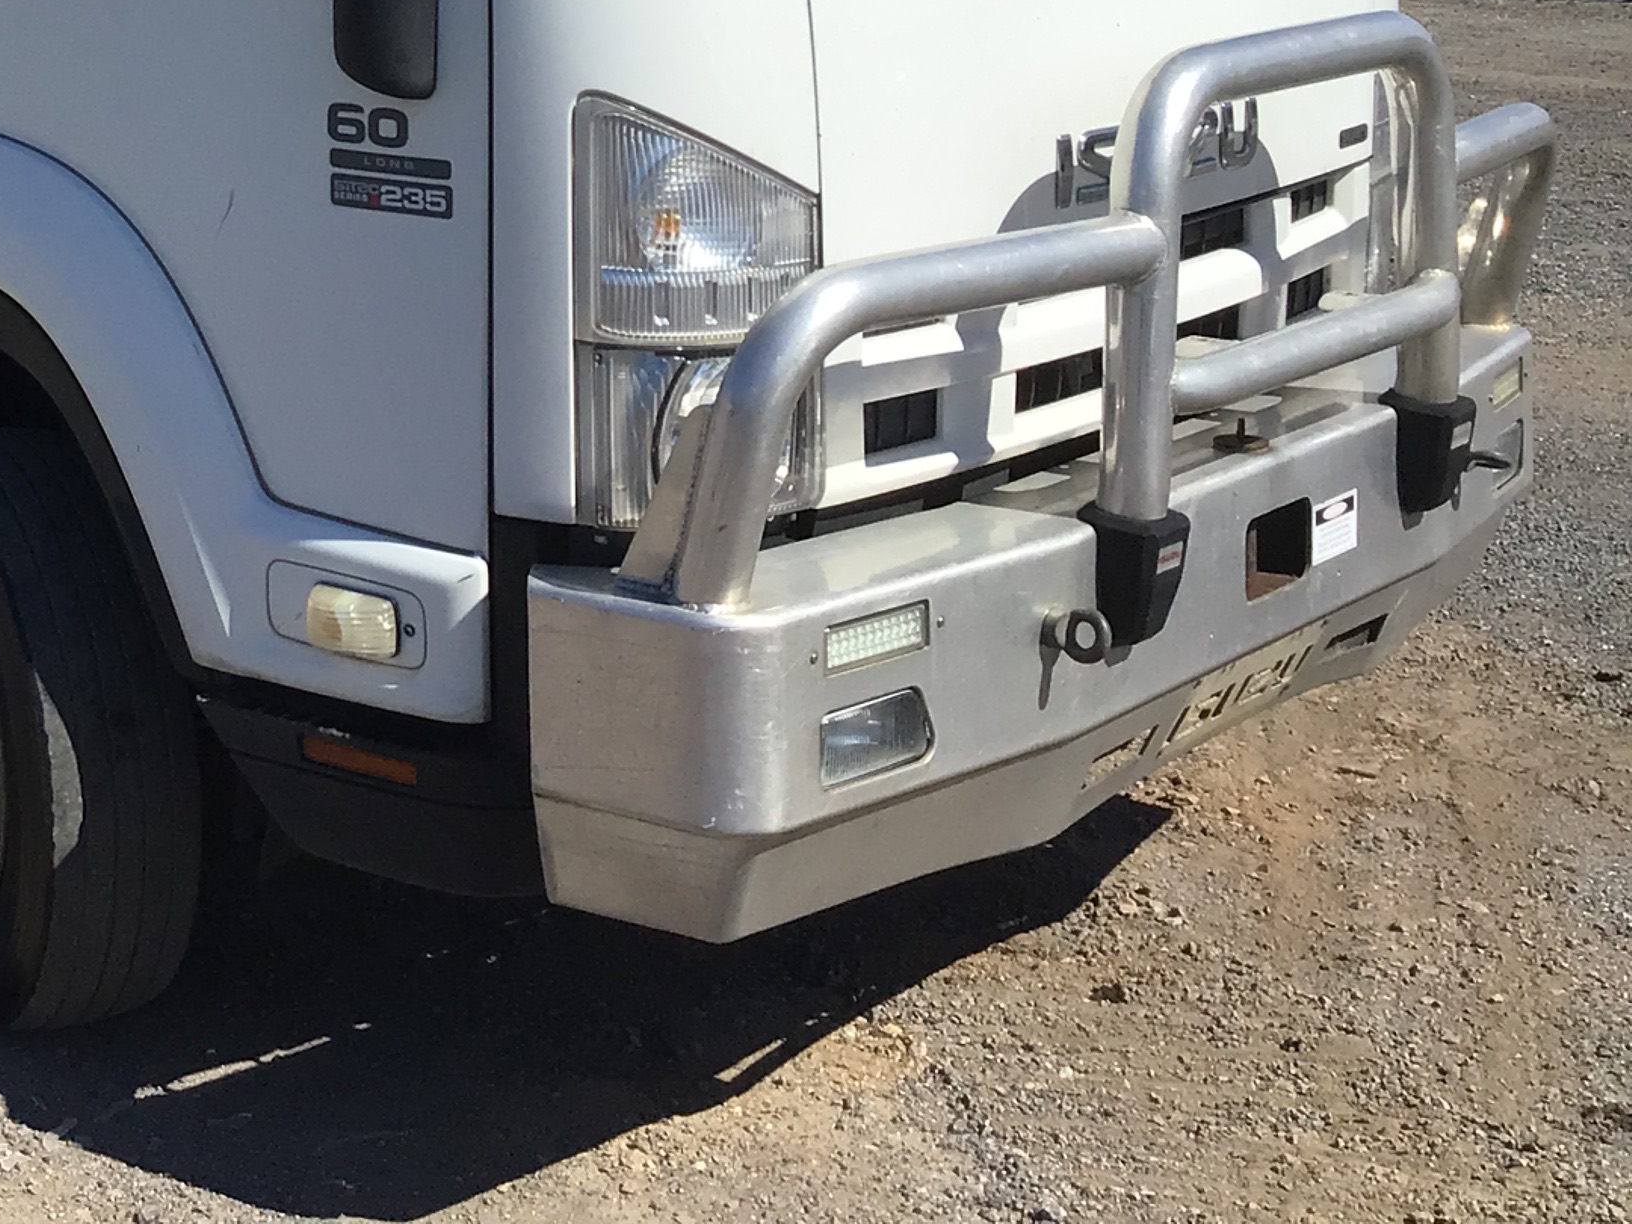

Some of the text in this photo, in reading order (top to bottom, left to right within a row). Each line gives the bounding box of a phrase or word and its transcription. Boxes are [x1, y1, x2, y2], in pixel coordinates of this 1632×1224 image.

[327, 102, 409, 148] 60
[363, 157, 415, 170] LONG
[380, 185, 447, 212] 235
